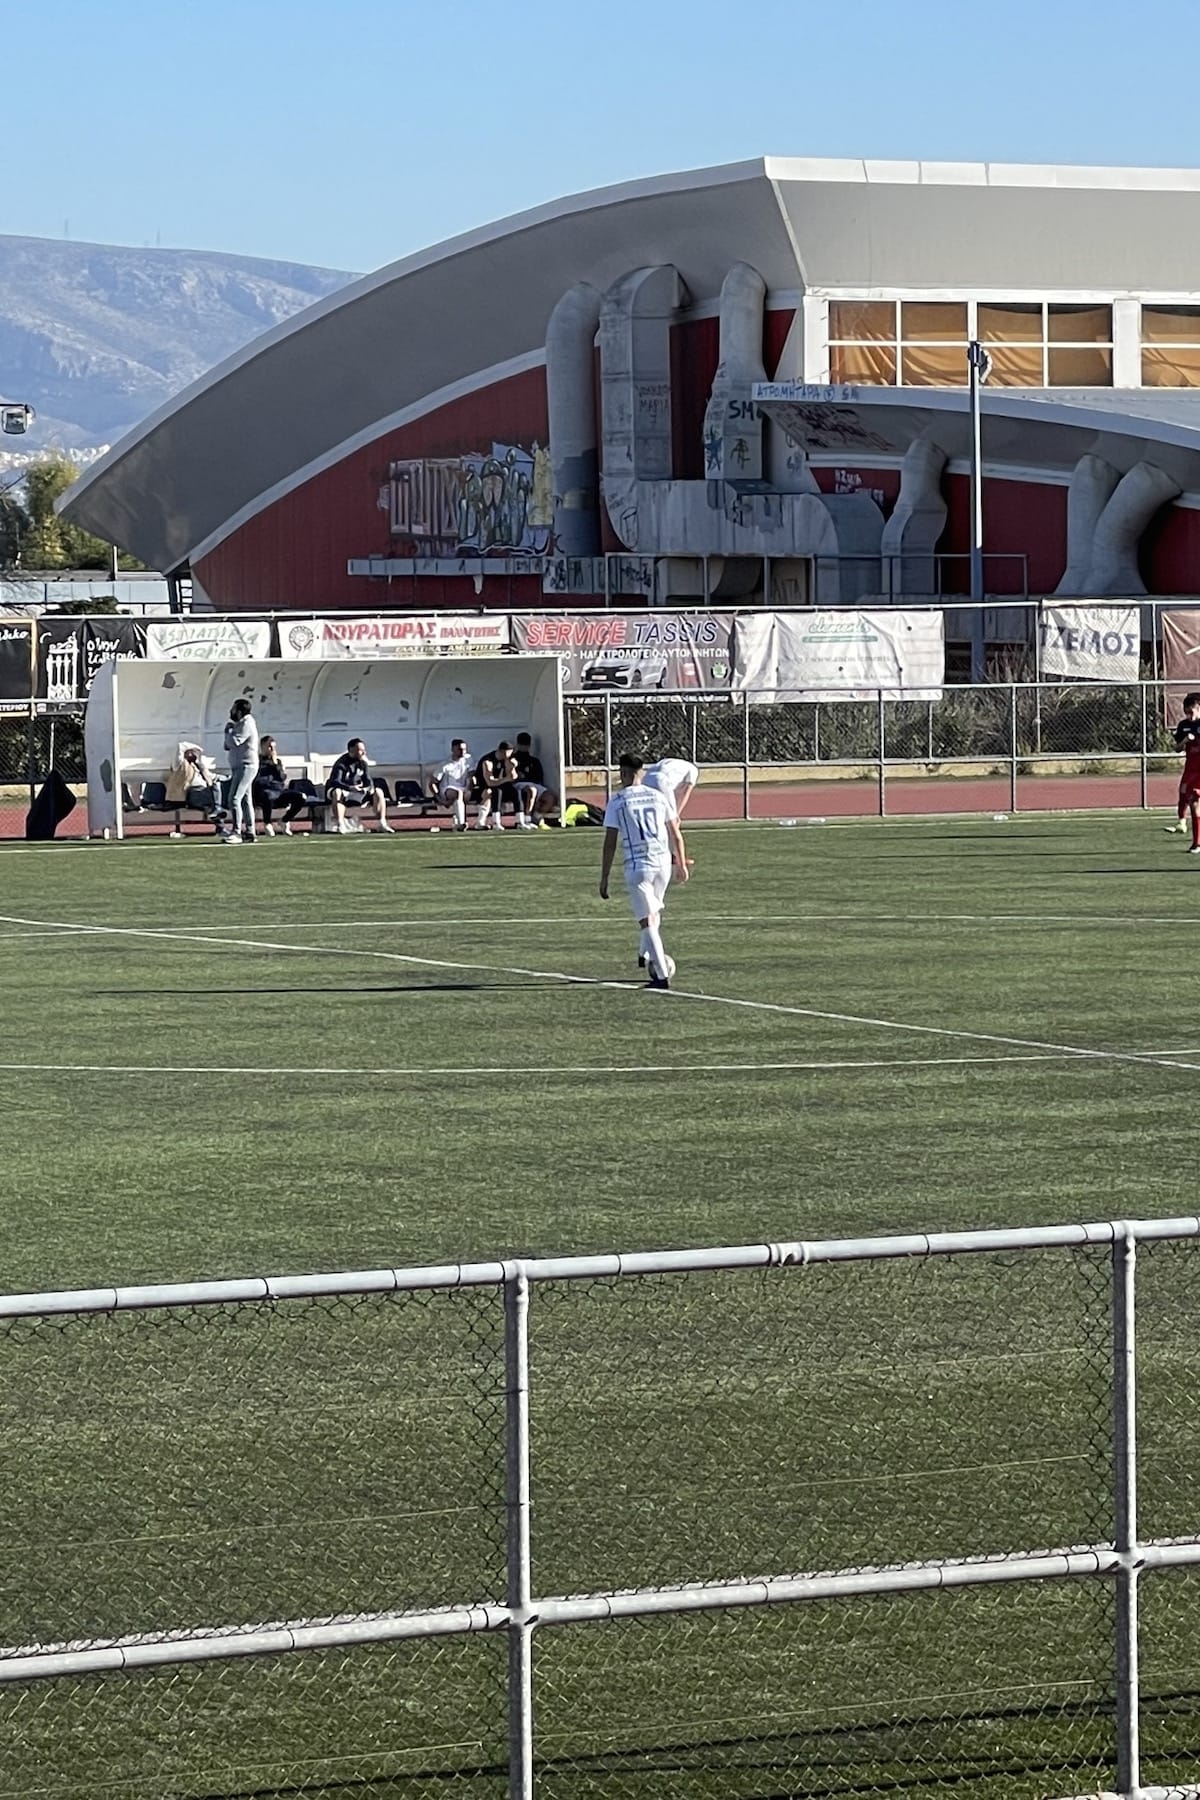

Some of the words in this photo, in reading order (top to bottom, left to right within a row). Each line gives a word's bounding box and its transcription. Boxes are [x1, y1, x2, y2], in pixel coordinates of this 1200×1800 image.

[526, 621, 627, 646] SERVICE
[633, 620, 719, 645] TASSIS
[808, 616, 871, 634] elements
[1039, 624, 1138, 656] ΤΖΕΜΟΣ
[633, 807, 658, 840] 10
